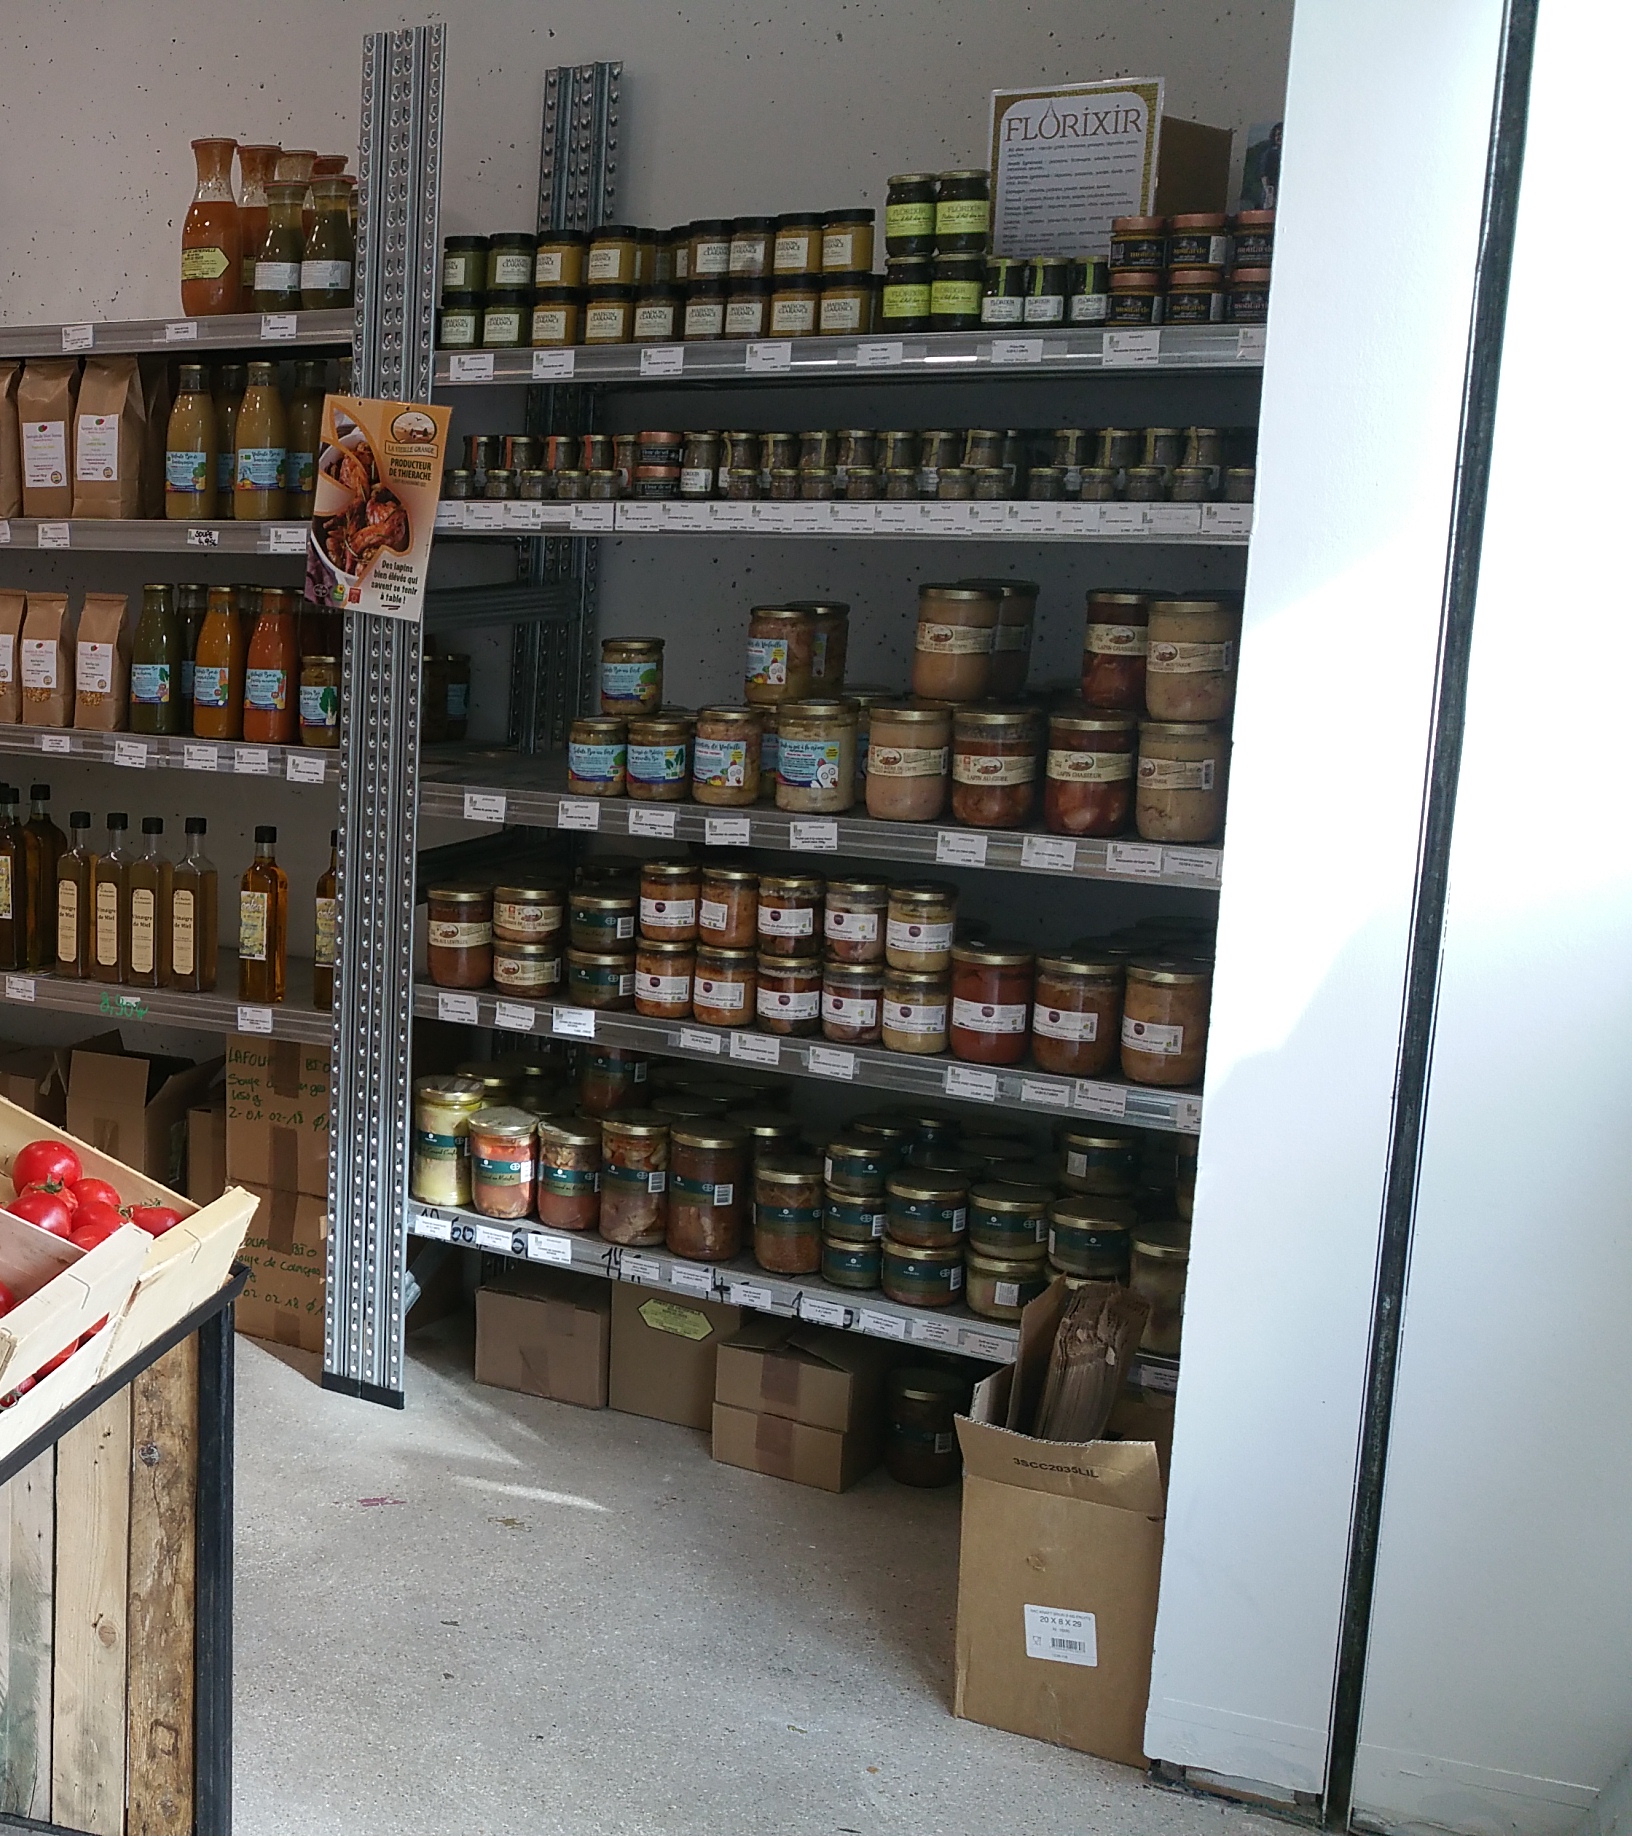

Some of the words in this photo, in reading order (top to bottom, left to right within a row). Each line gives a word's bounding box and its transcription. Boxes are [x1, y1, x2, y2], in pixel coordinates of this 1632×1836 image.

[1004, 100, 1142, 142] FLORIXIR
[390, 457, 432, 471] PRODUCTEUR
[388, 467, 397, 477] DE
[382, 560, 393, 569] Des
[394, 561, 413, 573] lapins
[1039, 1615, 1049, 1623] 20
